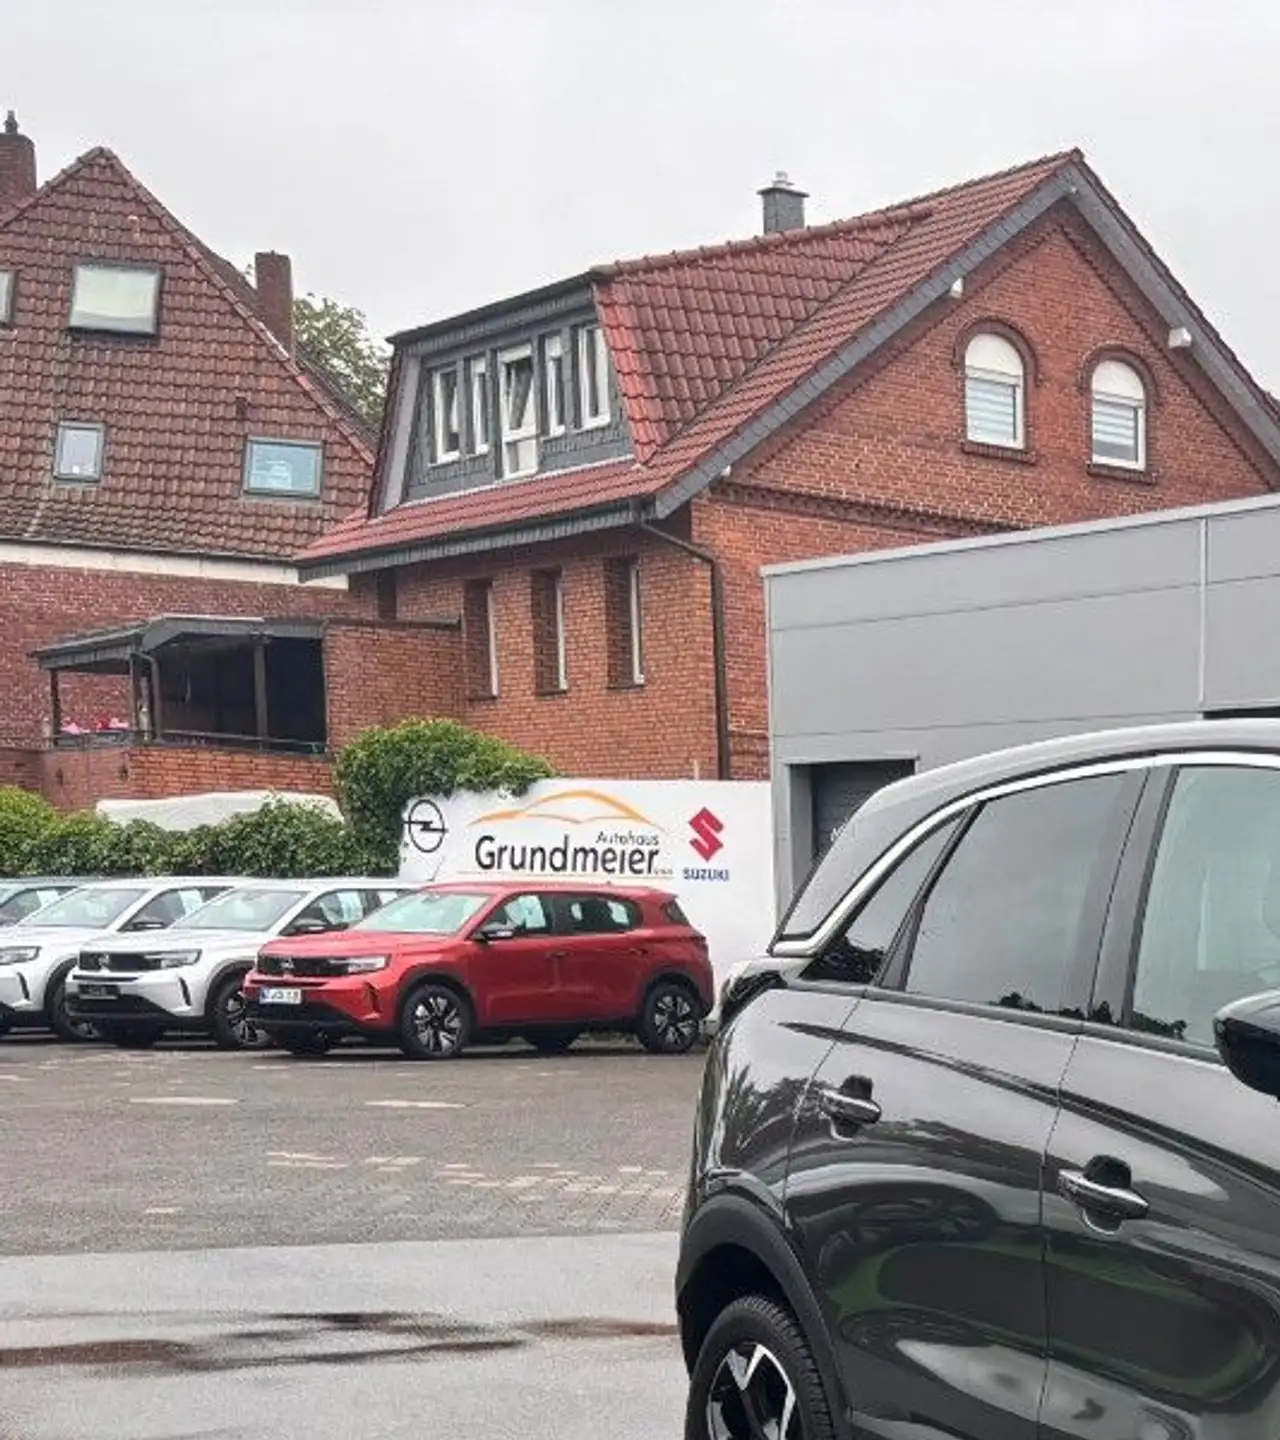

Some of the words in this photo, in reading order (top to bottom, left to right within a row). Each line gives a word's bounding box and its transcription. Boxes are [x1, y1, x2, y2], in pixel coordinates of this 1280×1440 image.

[595, 829, 659, 846] Autohaus
[475, 834, 660, 875] Grundmeier
[683, 866, 730, 881] SUZUKI
